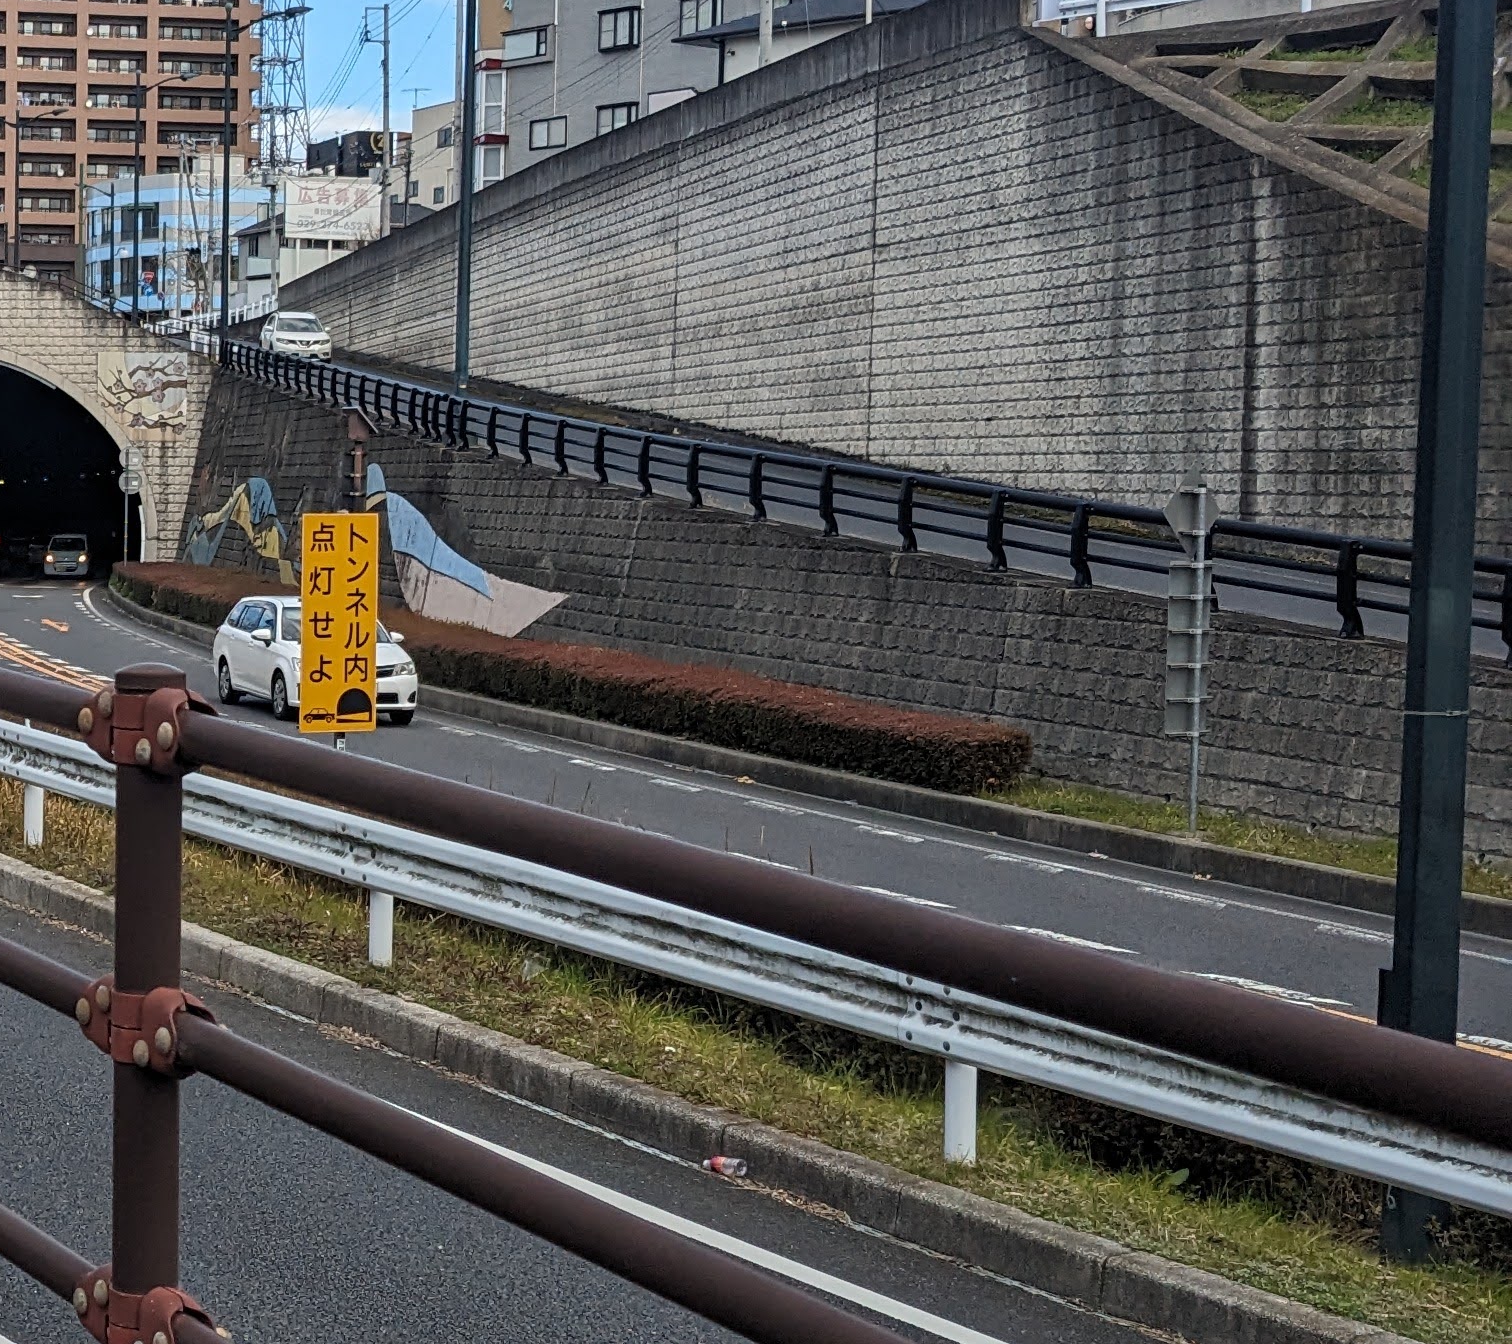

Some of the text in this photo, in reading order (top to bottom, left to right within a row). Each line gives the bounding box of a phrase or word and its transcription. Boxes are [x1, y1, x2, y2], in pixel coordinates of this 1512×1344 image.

[308, 522, 336, 683] 点灯せよ
[344, 524, 370, 683] トンネル内
